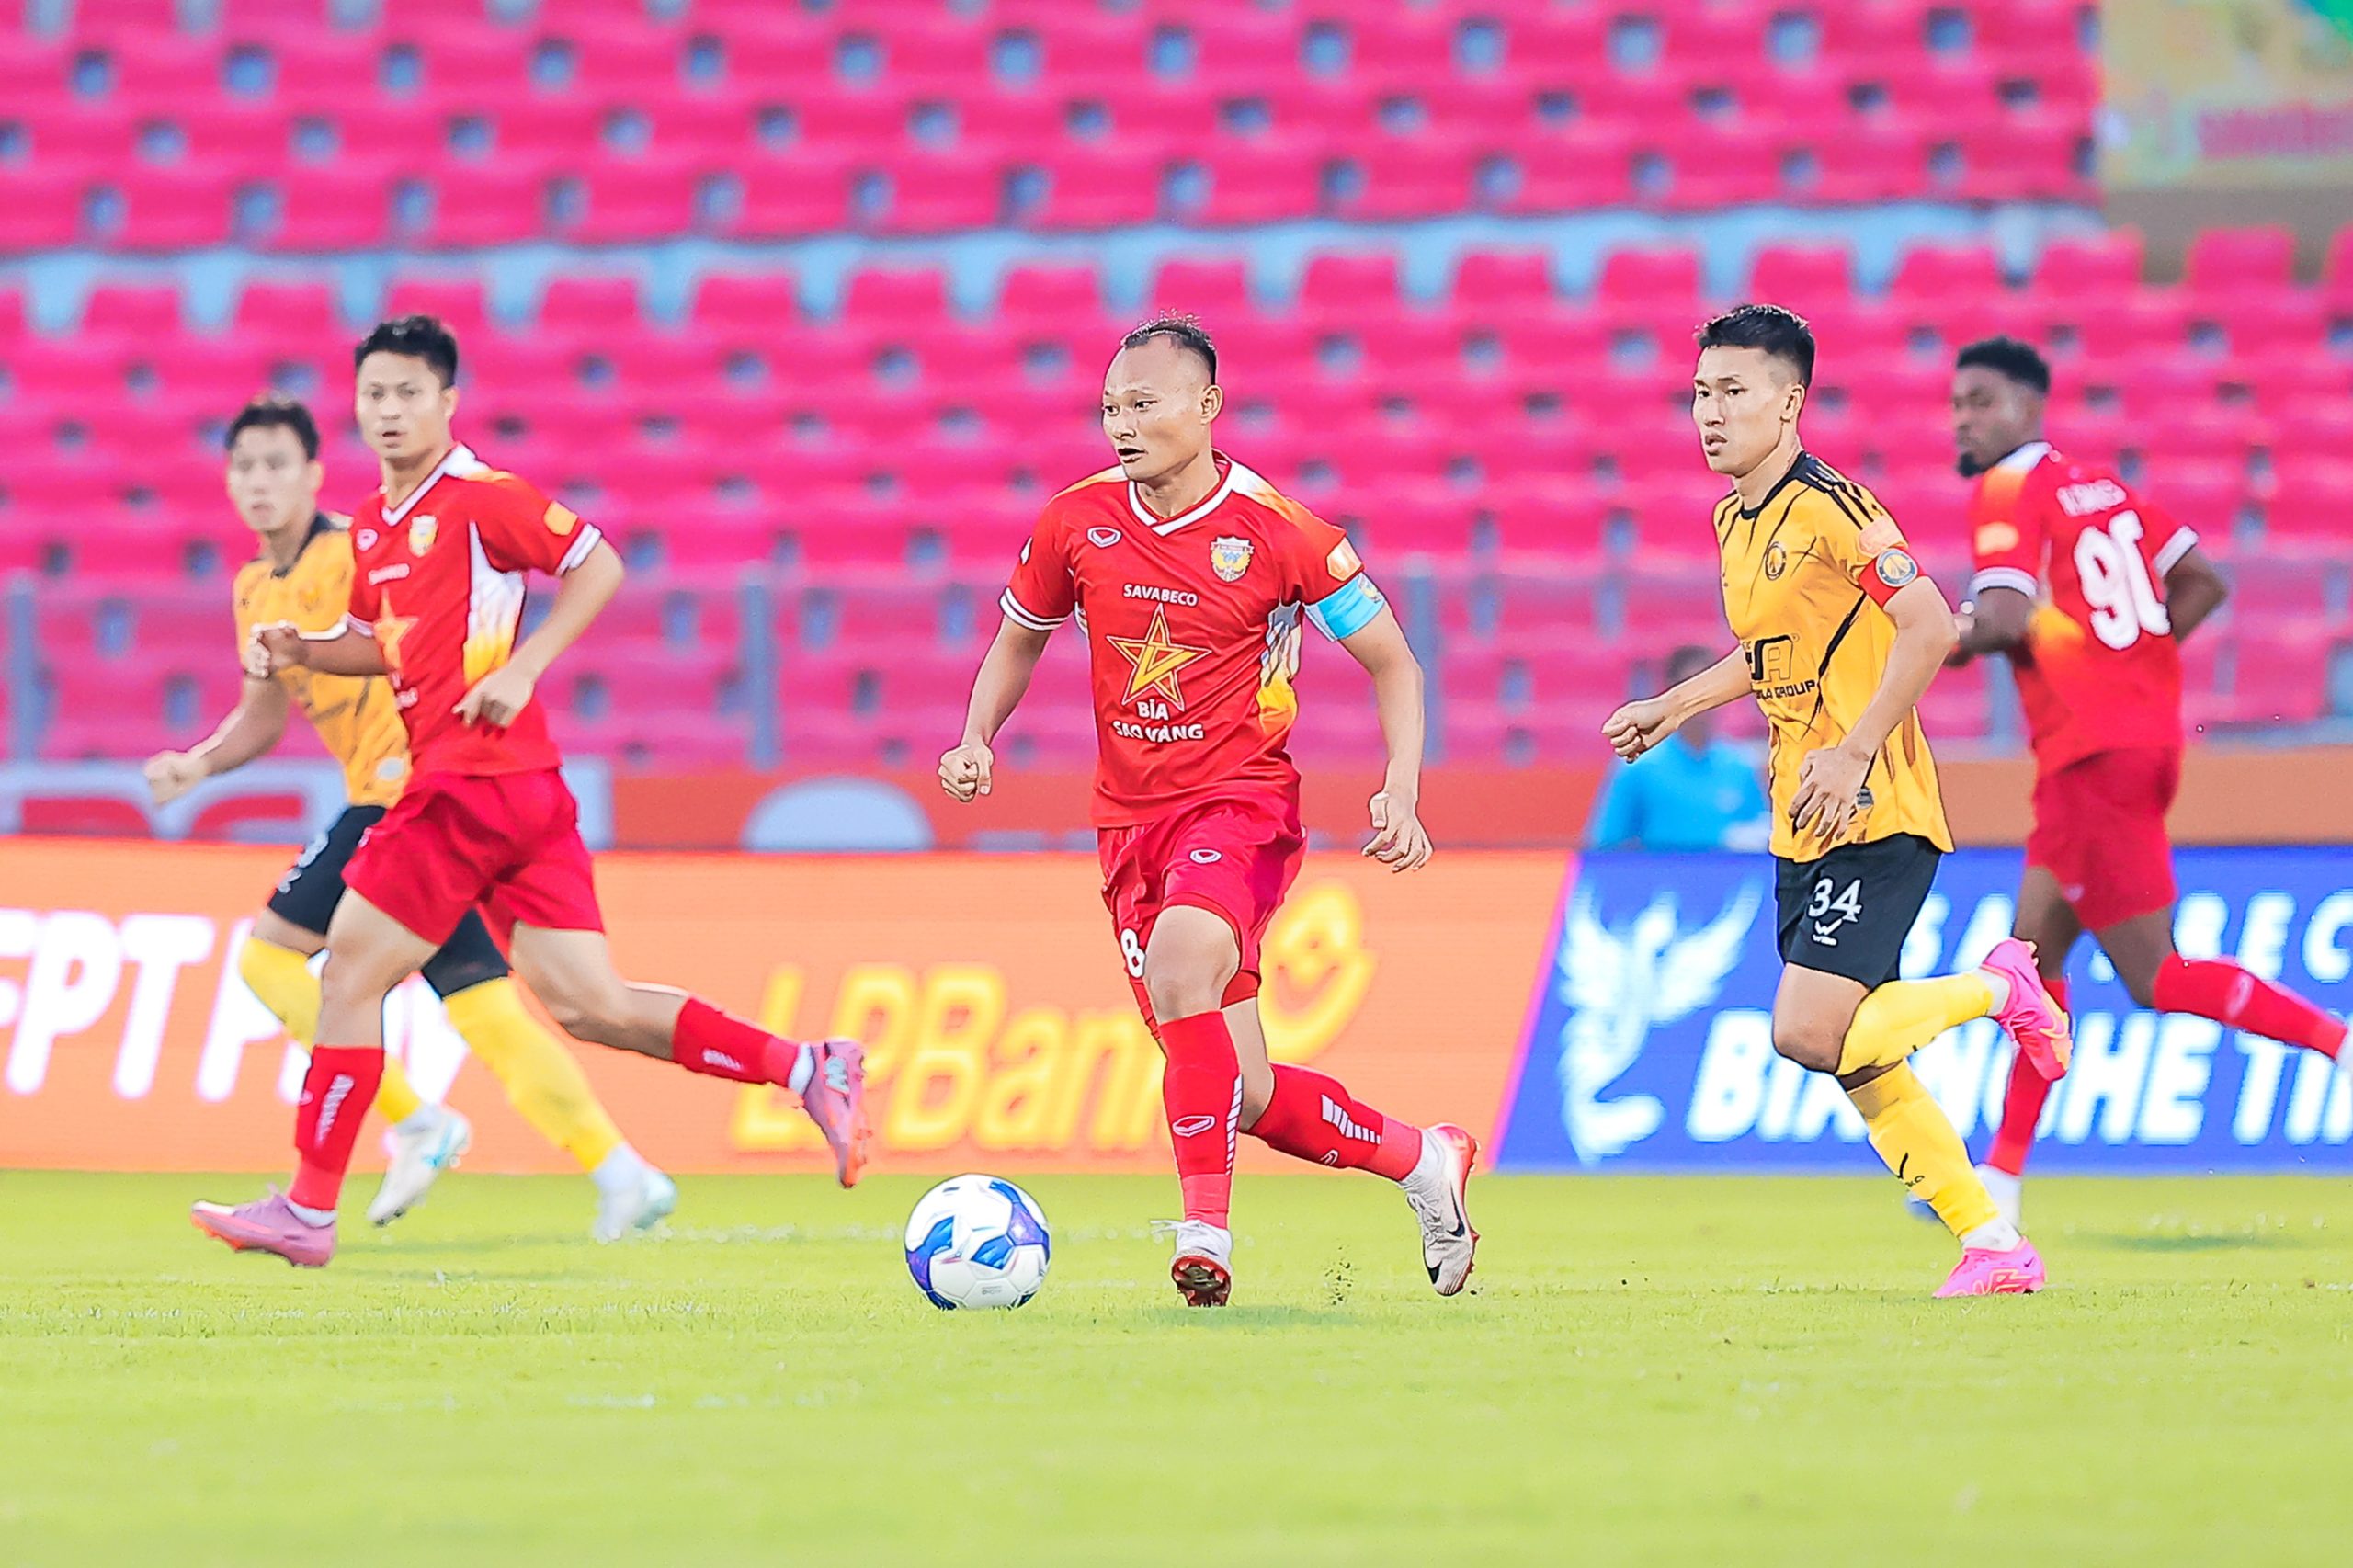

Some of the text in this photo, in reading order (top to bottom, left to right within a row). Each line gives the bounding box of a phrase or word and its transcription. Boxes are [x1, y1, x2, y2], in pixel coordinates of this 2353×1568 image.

[1123, 584, 1198, 607] SAVABECO
[1774, 679, 1815, 699] GROUP
[1808, 878, 1862, 923] 34
[735, 965, 1168, 1151] LPBan
